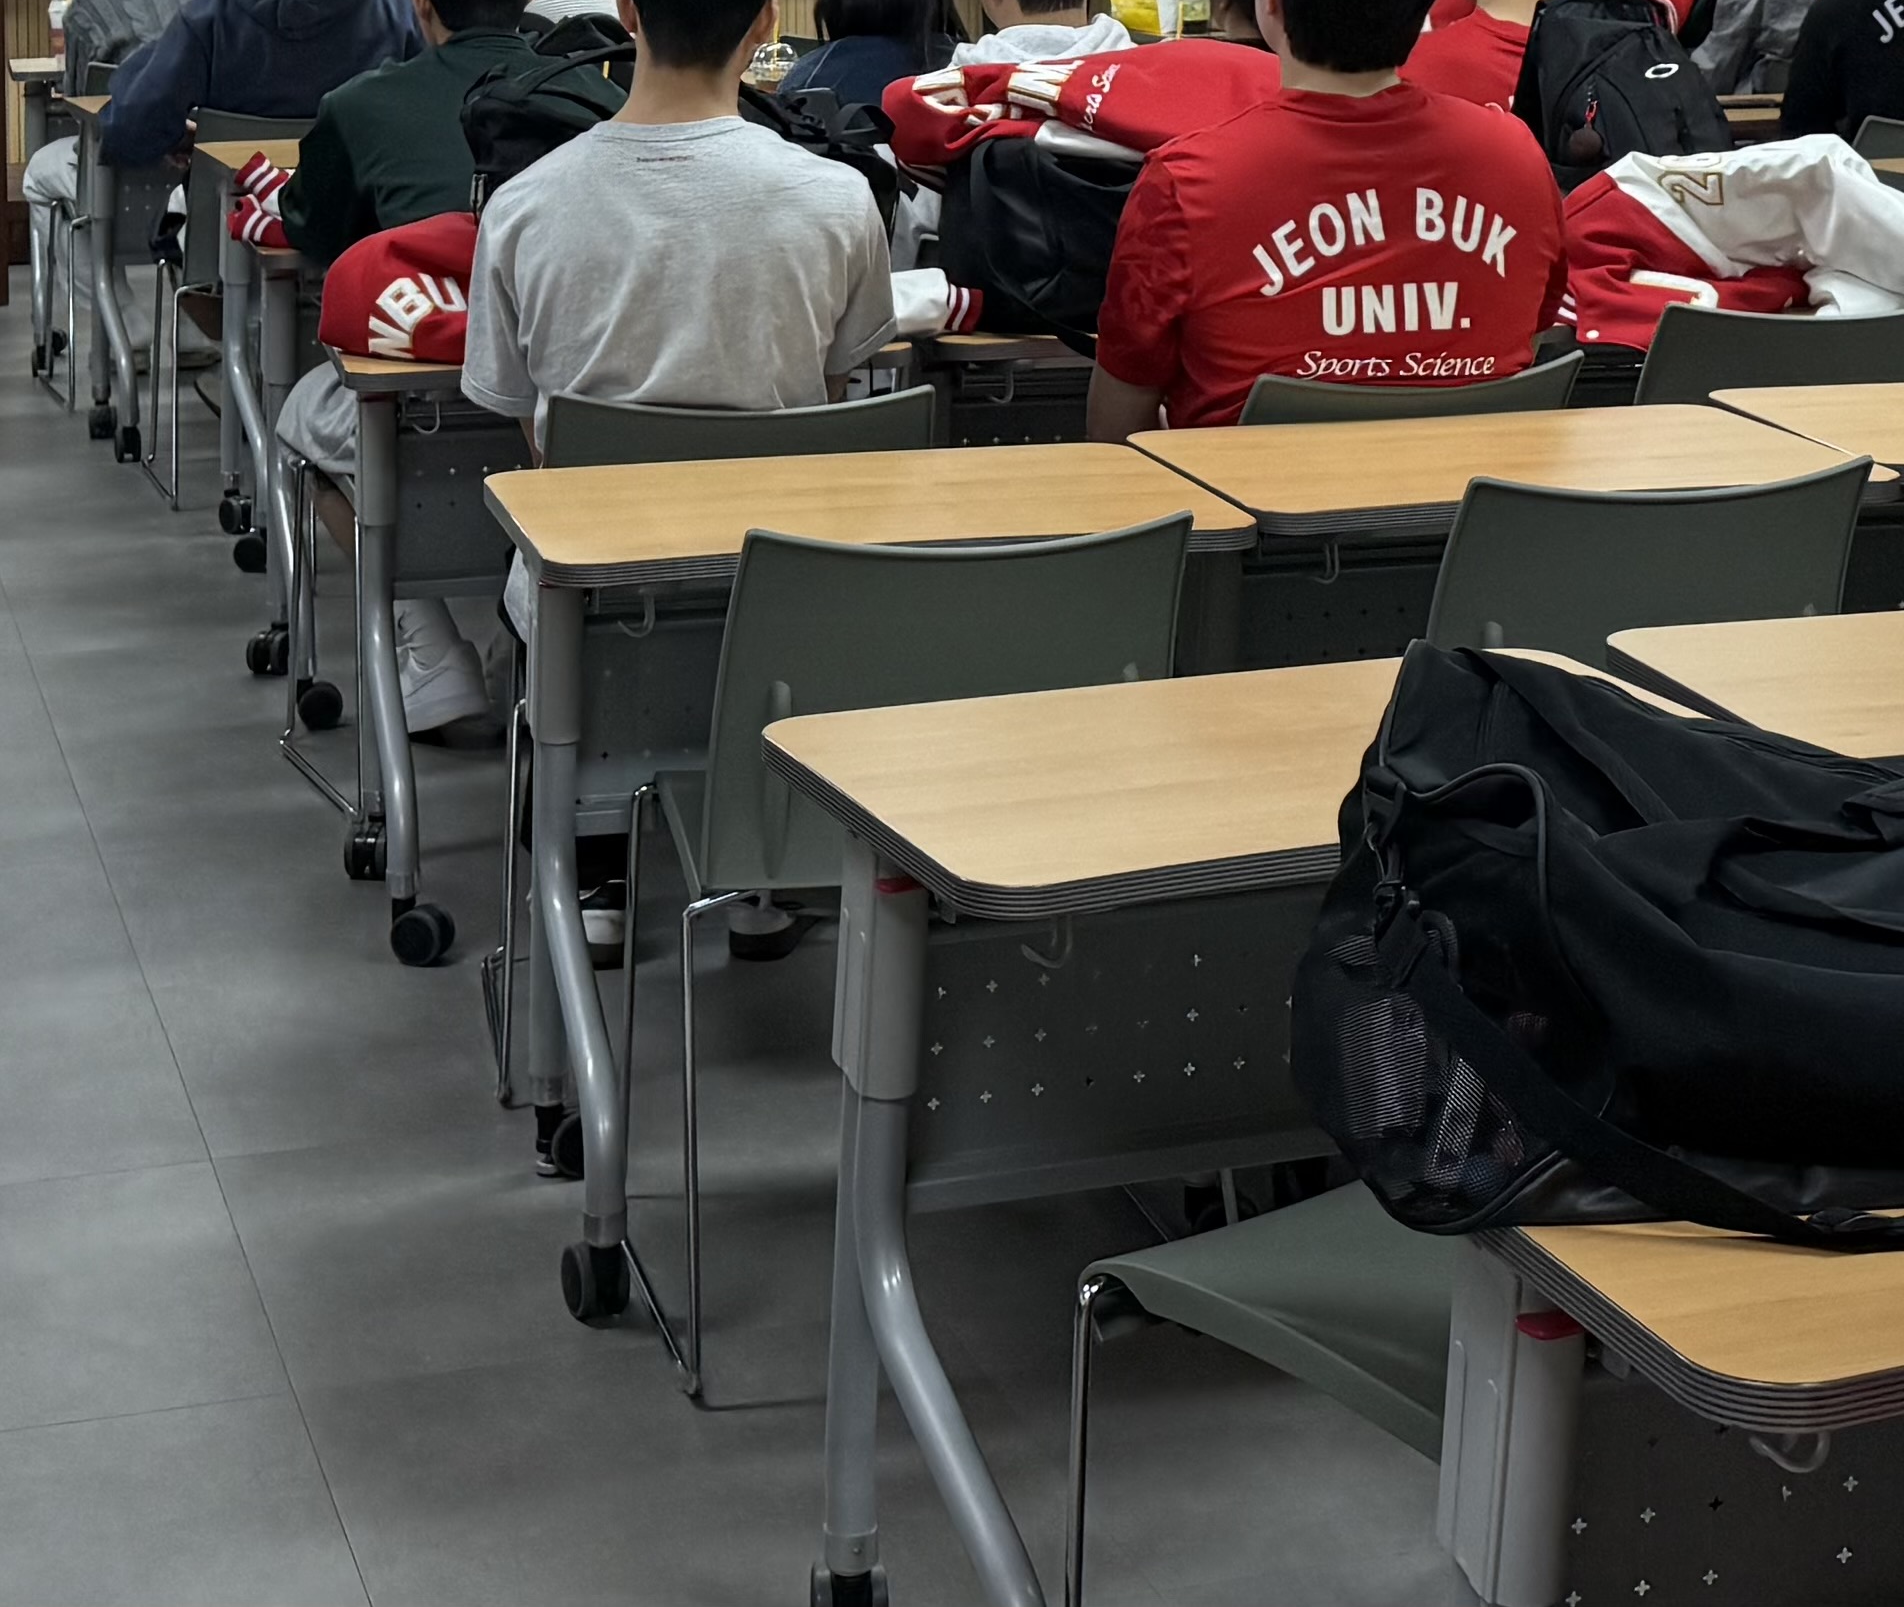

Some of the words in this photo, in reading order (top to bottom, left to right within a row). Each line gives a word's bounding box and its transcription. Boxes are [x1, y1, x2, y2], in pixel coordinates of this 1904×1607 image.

[1252, 188, 1386, 297] JEON
[1415, 187, 1518, 278] BUK
[1322, 281, 1471, 336] UNIV.
[1296, 350, 1393, 380] Sports
[1399, 351, 1496, 377] Science
